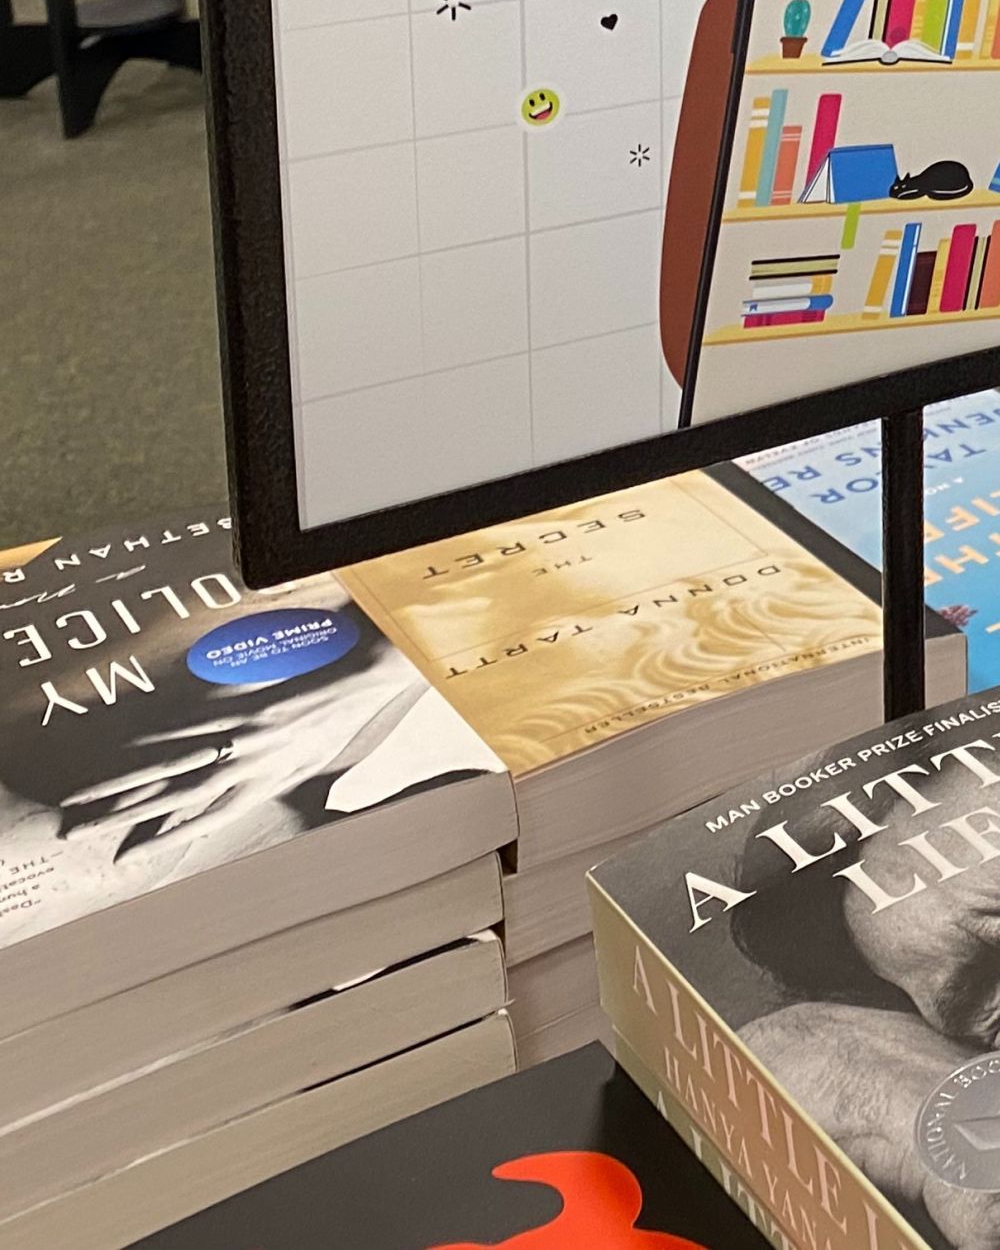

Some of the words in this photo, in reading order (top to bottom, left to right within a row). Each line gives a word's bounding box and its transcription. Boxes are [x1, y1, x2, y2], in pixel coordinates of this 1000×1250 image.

[810, 442, 987, 505] TAOR
[423, 508, 646, 580] SECRET
[532, 553, 593, 577] THE
[618, 563, 782, 619] DONNA
[2, 572, 243, 668] OLICE
[272, 618, 333, 641] PRIME
[278, 627, 338, 646] ORIGINAL
[290, 635, 330, 650] SOON
[206, 636, 269, 660] VIDEO
[213, 655, 233, 668] ON
[230, 657, 249, 669] AN
[238, 642, 277, 660] MOVIE
[252, 651, 270, 662] BE
[270, 645, 290, 656] TO
[444, 623, 595, 681] TARTT
[717, 636, 872, 685] INTERNATIONAL
[40, 654, 156, 726] MY
[584, 682, 711, 734] BESTSELLER
[704, 798, 762, 835] MAN
[761, 755, 857, 806] BOOKER
[857, 726, 925, 764] PRIZE
[682, 870, 758, 934] A
[633, 944, 658, 1016] A
[667, 979, 848, 1235] LITTLE
[664, 1047, 754, 1180] HANYA
[926, 1092, 967, 1181] NATIONAL
